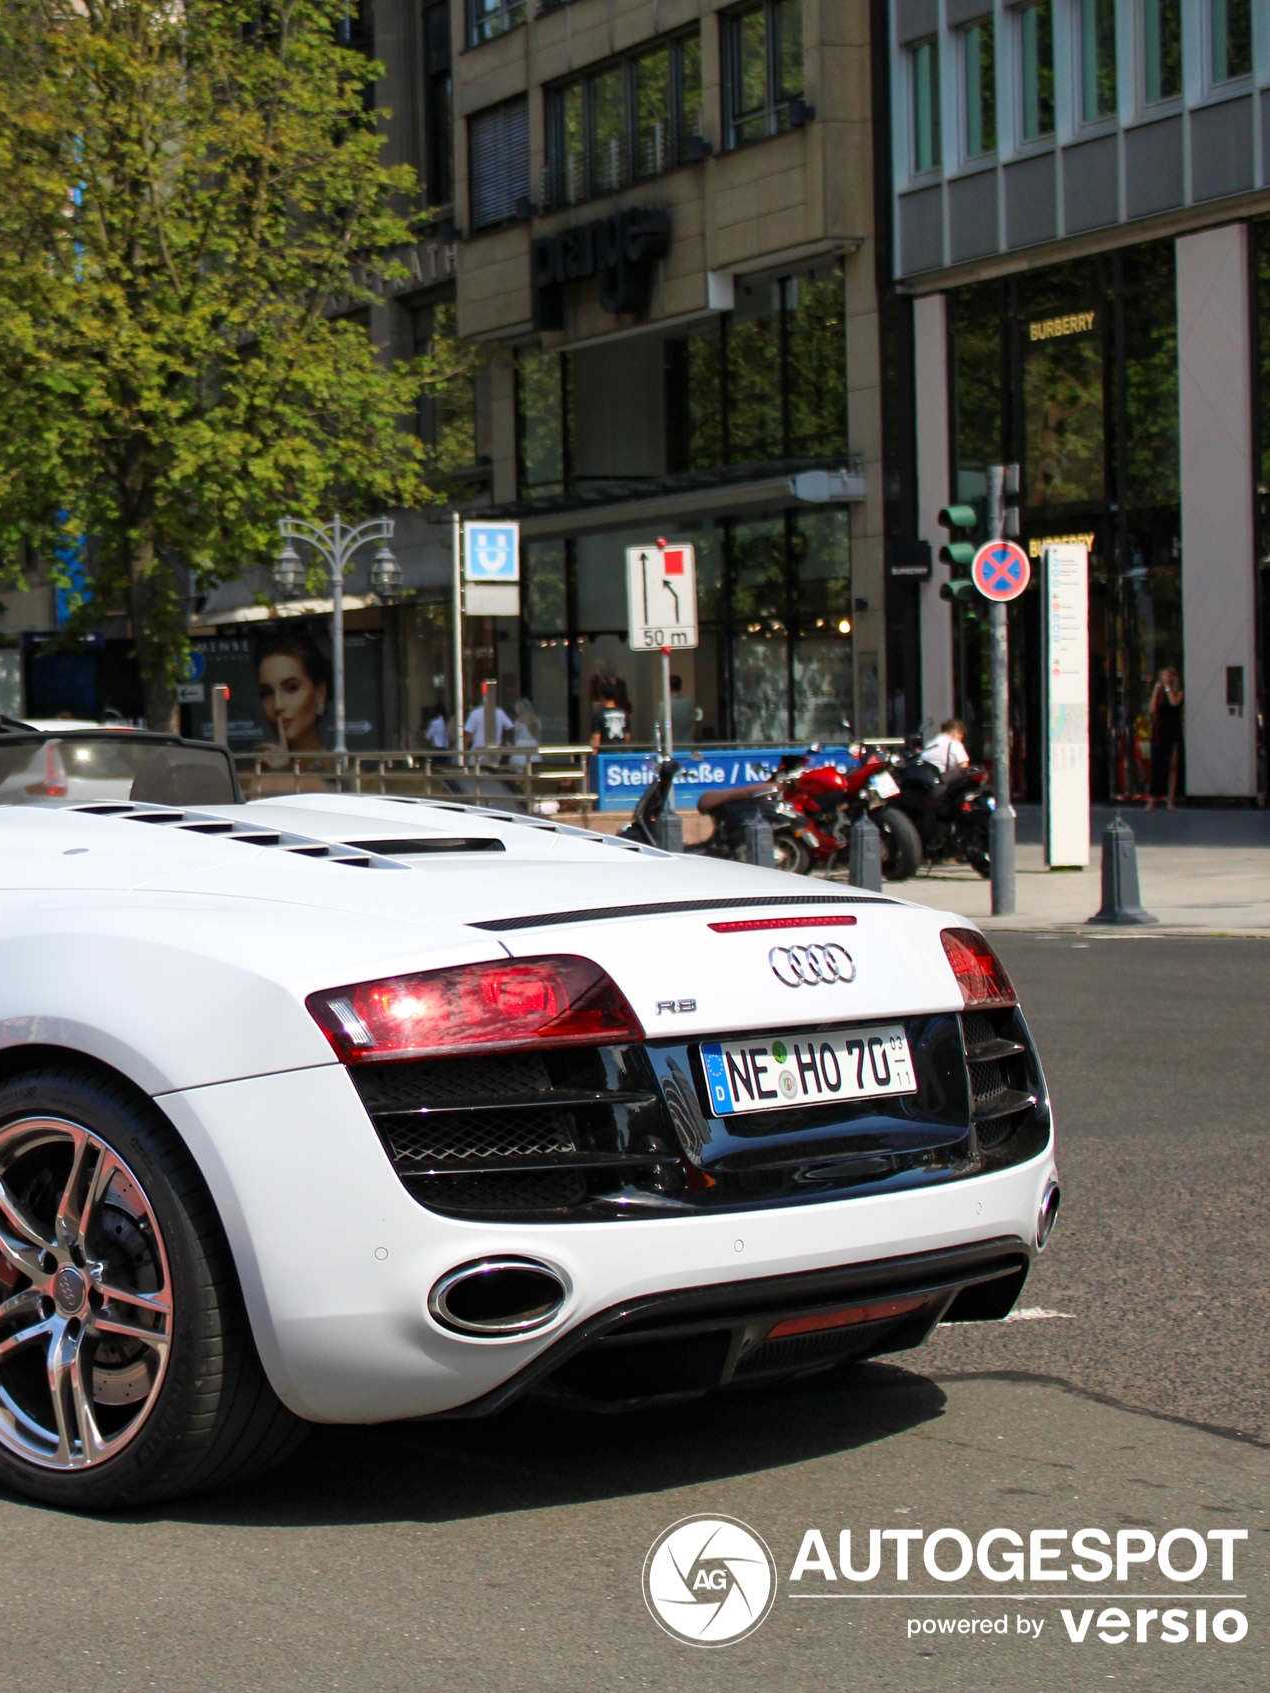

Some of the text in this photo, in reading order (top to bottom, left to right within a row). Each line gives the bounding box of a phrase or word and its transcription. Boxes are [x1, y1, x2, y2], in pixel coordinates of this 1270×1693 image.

[1030, 311, 1095, 341] BURBERRY
[644, 630, 688, 647] 50 m
[656, 998, 697, 1016] R8
[889, 1036, 903, 1050] 03
[725, 1037, 891, 1102] NE HO 70
[896, 1071, 911, 1085] 11
[715, 1086, 725, 1101] D
